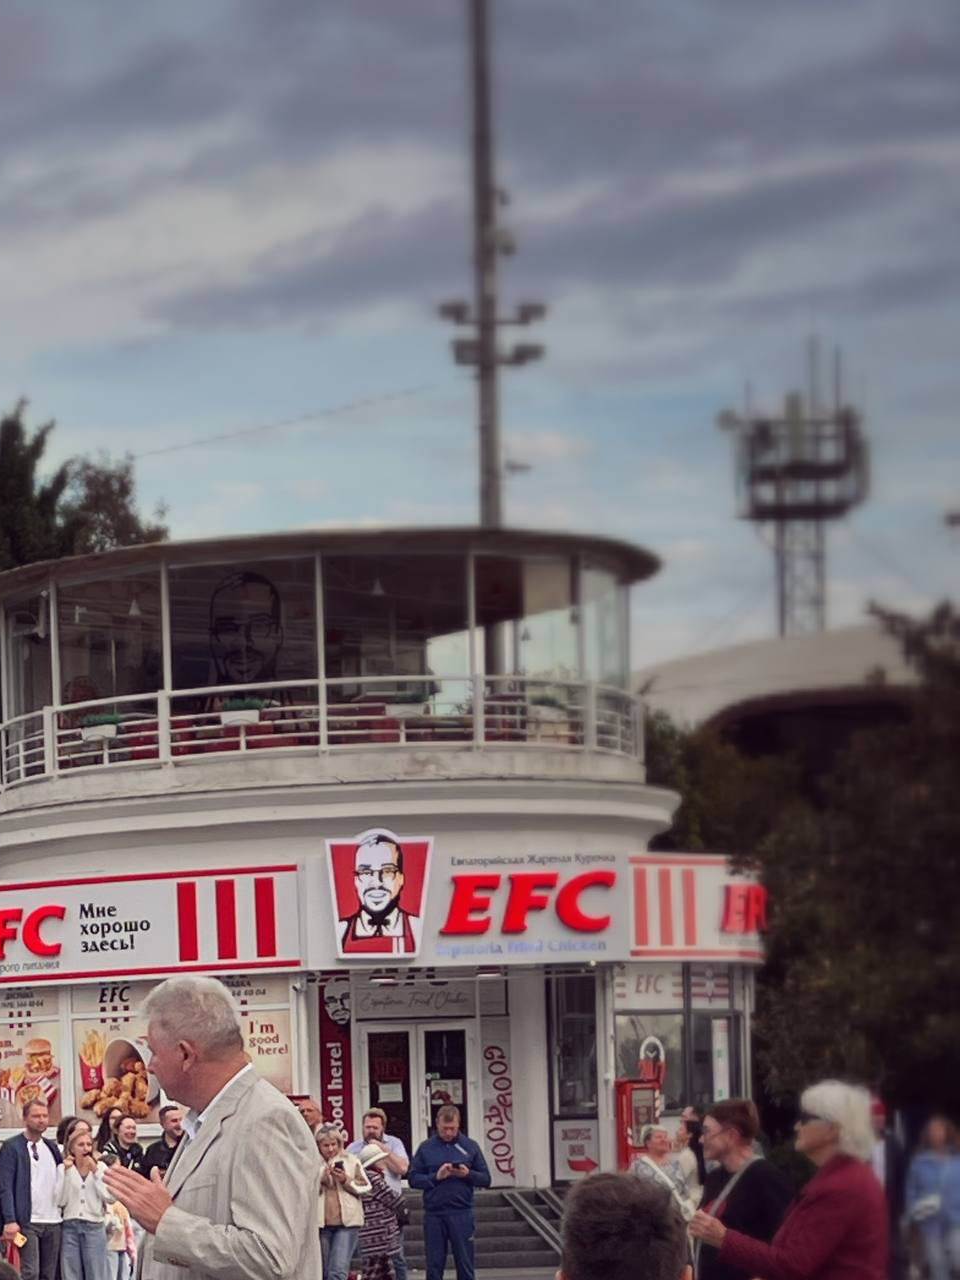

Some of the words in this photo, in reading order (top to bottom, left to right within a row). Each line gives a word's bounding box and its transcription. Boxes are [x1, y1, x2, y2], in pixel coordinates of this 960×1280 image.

[574, 853, 616, 864] Курочка
[79, 903, 117, 920] Мне
[438, 870, 617, 936] EFC
[80, 918, 151, 938] хорошо
[80, 934, 135, 953] здесь!
[22, 960, 60, 971] питания
[634, 974, 665, 994] EFC
[99, 986, 131, 1003] EFC
[249, 1021, 275, 1034] I'm
[249, 1034, 280, 1048] good
[257, 1044, 289, 1055] here!
[326, 1042, 343, 1090] here!
